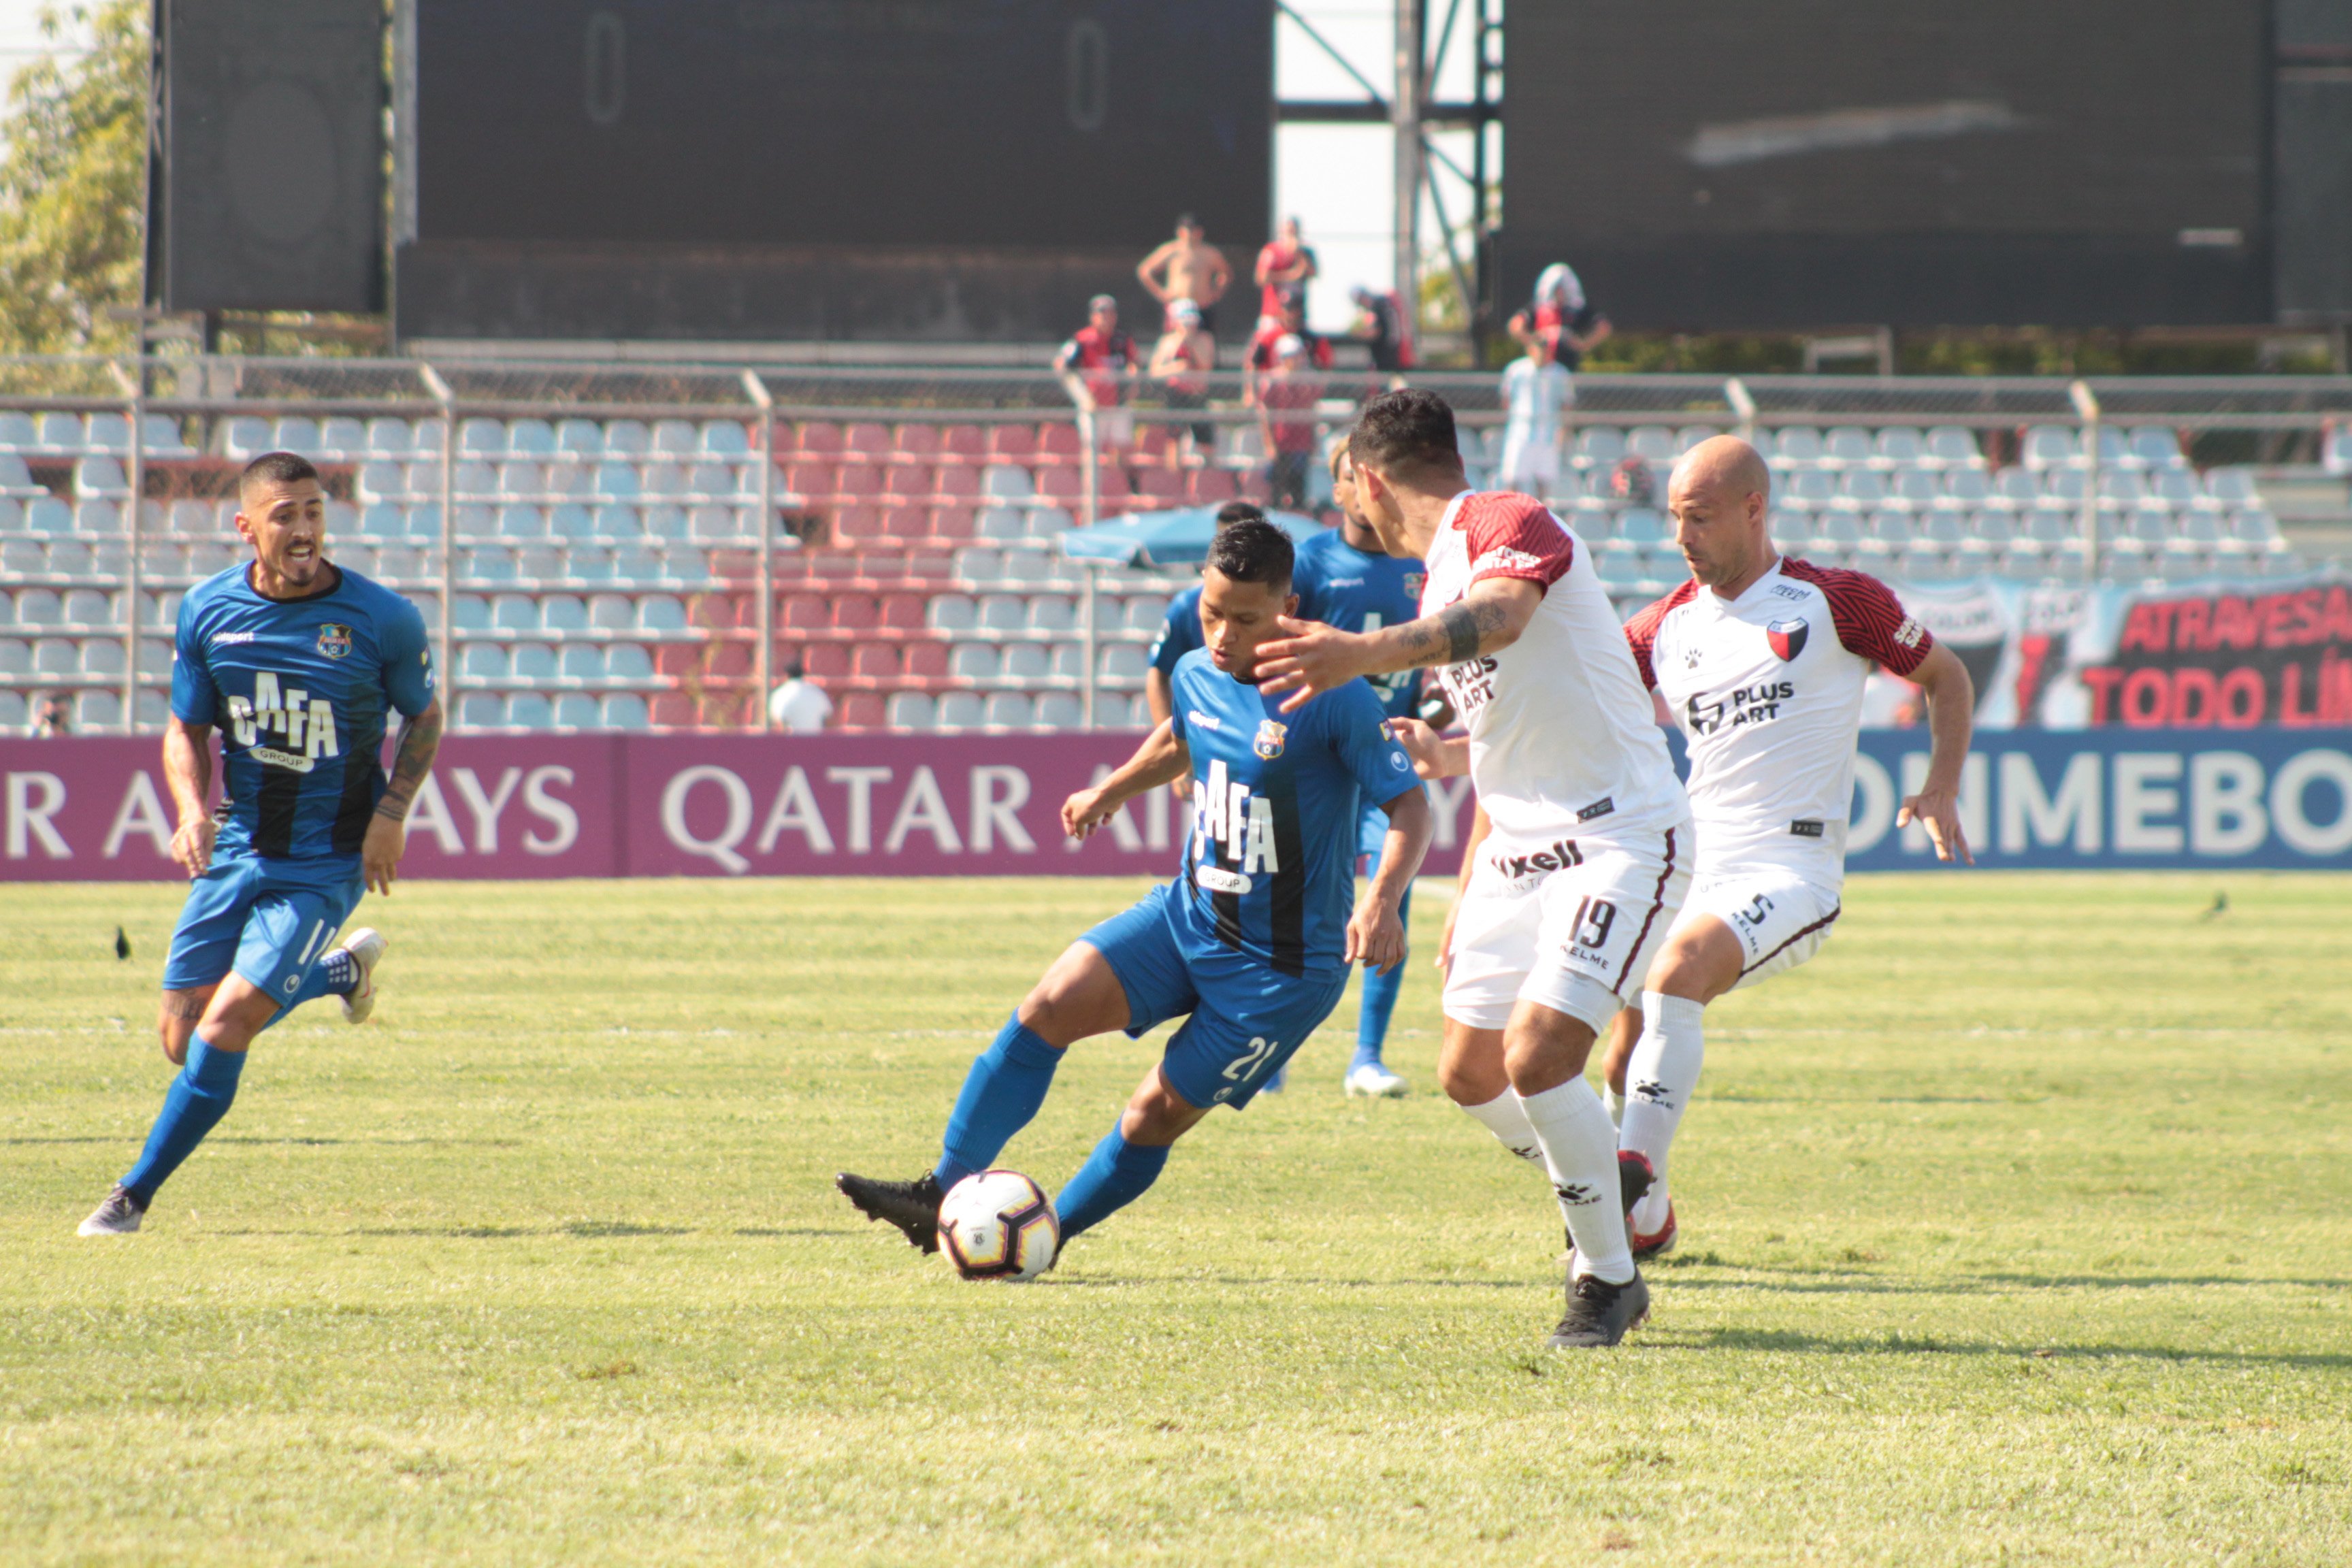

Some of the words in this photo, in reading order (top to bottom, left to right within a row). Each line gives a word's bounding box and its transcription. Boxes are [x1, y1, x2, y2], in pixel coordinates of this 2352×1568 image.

[1451, 655, 1499, 690] PLUS
[1463, 679, 1495, 715] ART
[1733, 681, 1795, 706] PLUS
[2082, 666, 2266, 730] TODO
[228, 672, 339, 759] CAFA
[1732, 703, 1780, 727] ART
[260, 750, 304, 767] GROUP
[660, 765, 1038, 874] QATAR
[1194, 759, 1279, 873] CAFA
[1204, 872, 1241, 889] GROUP
[1567, 895, 1616, 949] 19
[1741, 893, 1775, 925] 5
[1731, 912, 1759, 956] KELME
[1222, 1036, 1278, 1082] 21
